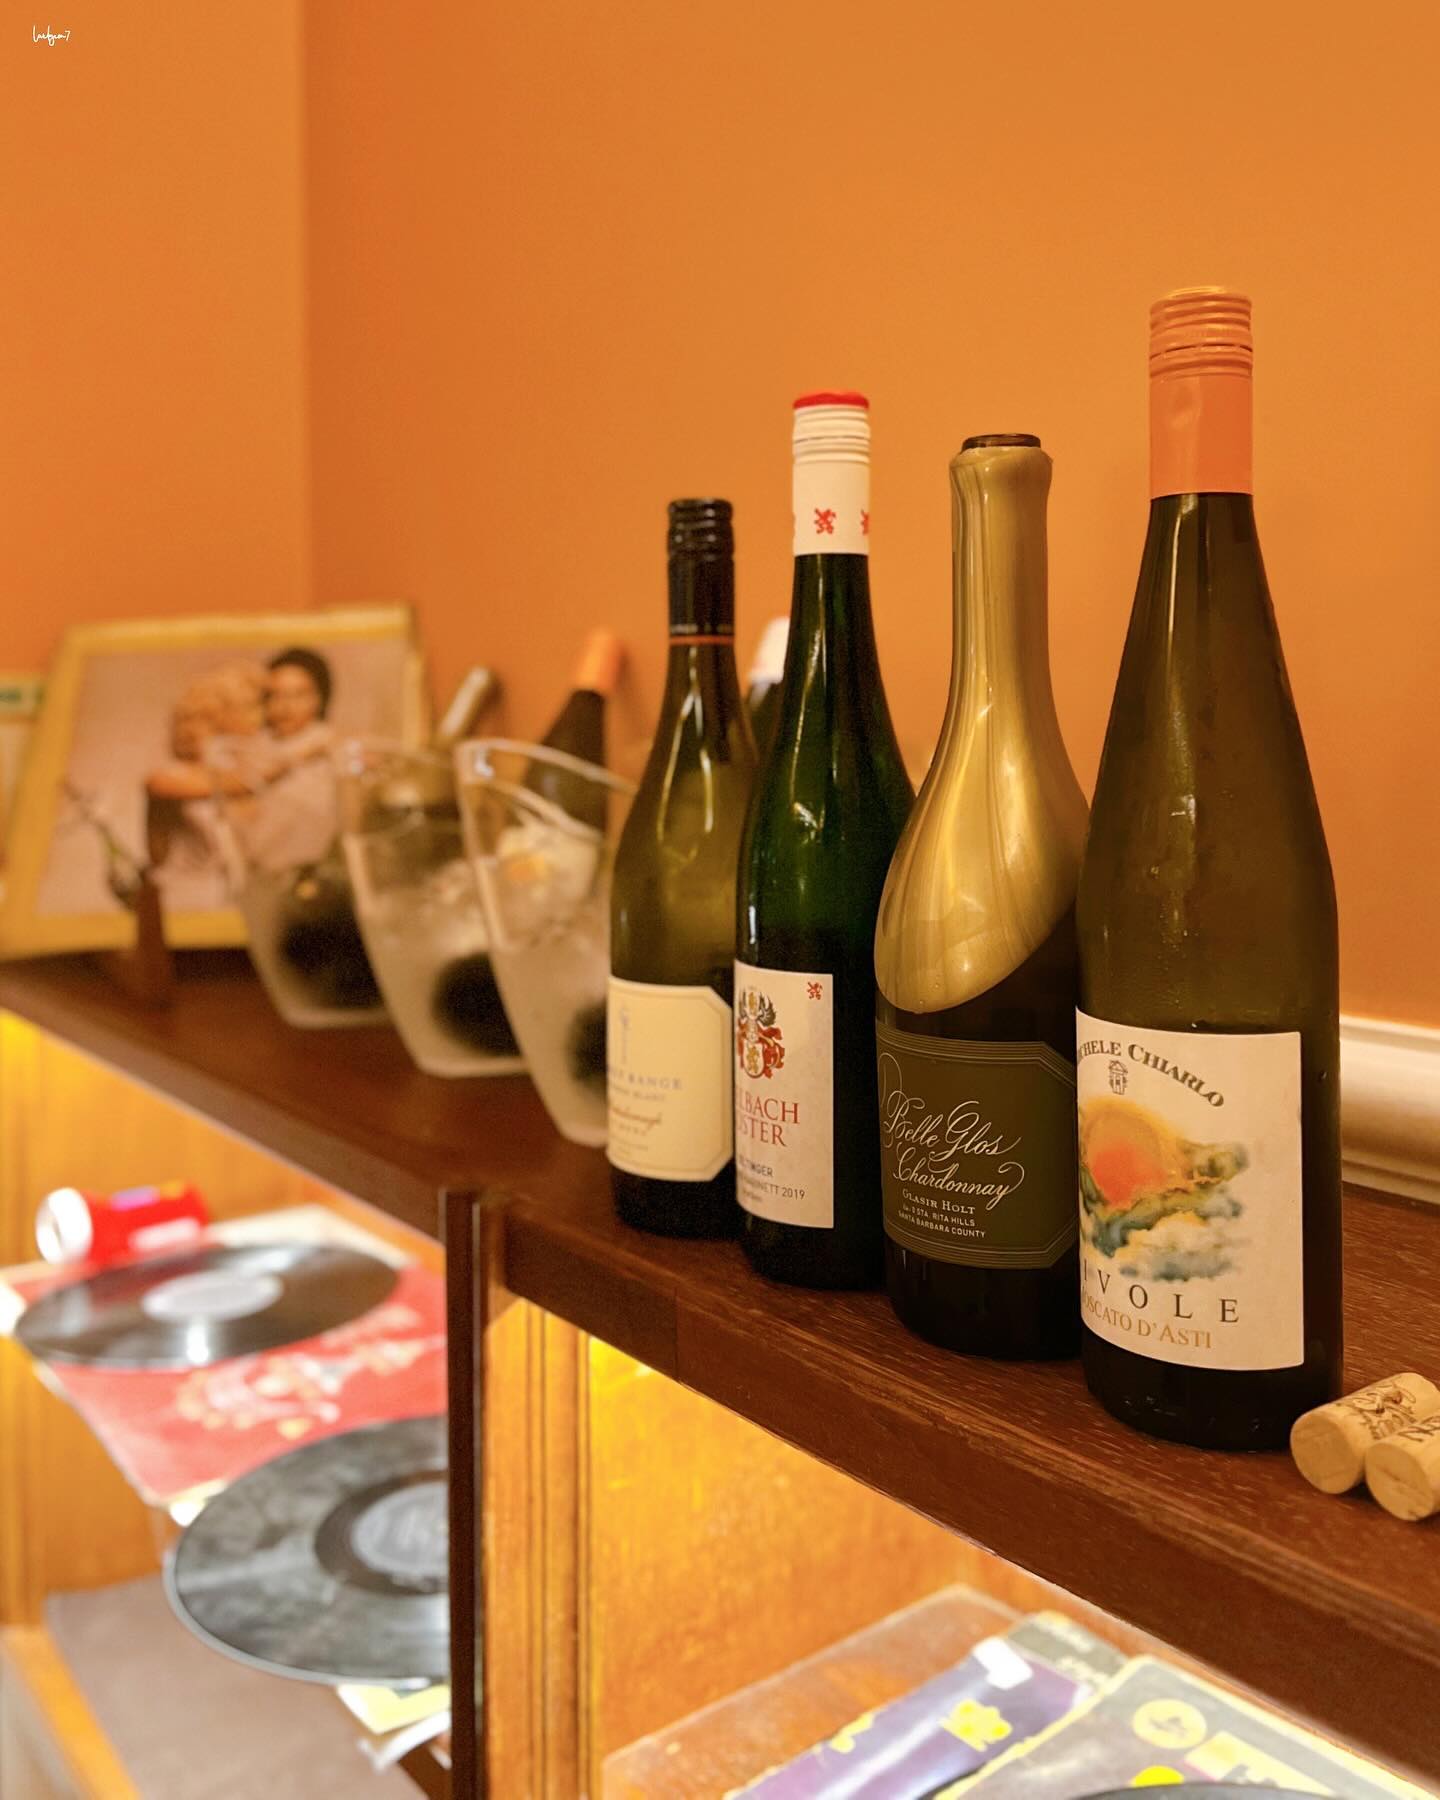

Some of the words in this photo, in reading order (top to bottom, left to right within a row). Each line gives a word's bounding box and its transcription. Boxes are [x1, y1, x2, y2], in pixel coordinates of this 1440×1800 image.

[1127, 1043, 1225, 1108] CHIARLO
[877, 1076, 943, 1149] Belle
[928, 1100, 1022, 1163] Glos
[892, 1141, 1025, 1211] Chardonnay
[781, 1187, 805, 1200] 2019
[942, 1200, 976, 1215] HOLT
[916, 1218, 950, 1232] BARBARA
[951, 1227, 985, 1238] COUNTY
[932, 1211, 949, 1223] RITA
[951, 1217, 975, 1227] HILLS
